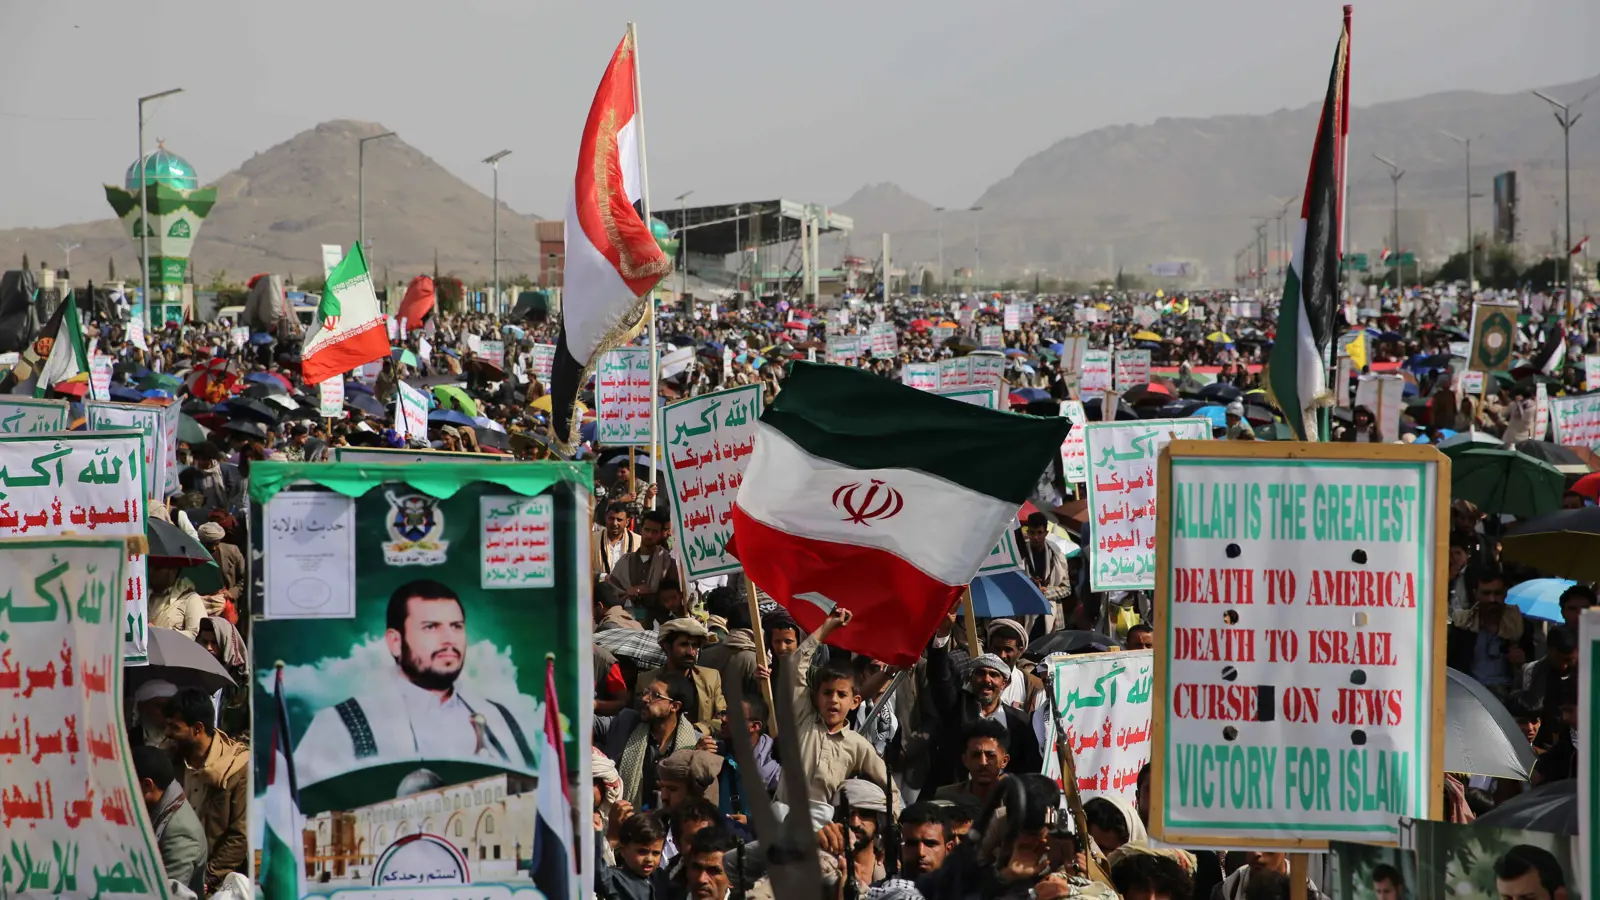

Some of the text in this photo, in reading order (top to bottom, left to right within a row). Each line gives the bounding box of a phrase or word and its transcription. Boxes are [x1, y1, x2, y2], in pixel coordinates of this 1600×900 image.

[669, 398, 755, 446] الله أكبر
[78, 447, 137, 485] الله
[672, 440, 721, 470] لأمريكا
[1094, 429, 1159, 470] أكبر
[0, 443, 73, 500] أكب
[680, 472, 726, 503] لإسرائيل
[1095, 465, 1154, 495] لأمريكا
[69, 498, 137, 530] الموت
[272, 516, 345, 539] حديث الولاية
[684, 504, 715, 532] اليهود
[1174, 482, 1416, 542] ALLAH IS THE GREATEST
[1099, 528, 1140, 553] اليهود
[0, 553, 70, 643] أكب
[77, 562, 114, 624] الله
[1174, 567, 1416, 609] DEATH TO AMERICA
[1174, 627, 1397, 668] DEATH TO ISRAEL
[1126, 664, 1153, 705] لله
[1282, 687, 1321, 724] ON
[1332, 688, 1403, 728] JEWS
[1176, 743, 1411, 816] VICTORY FOR ISLAM
[383, 869, 456, 883] لستم وحدكم
